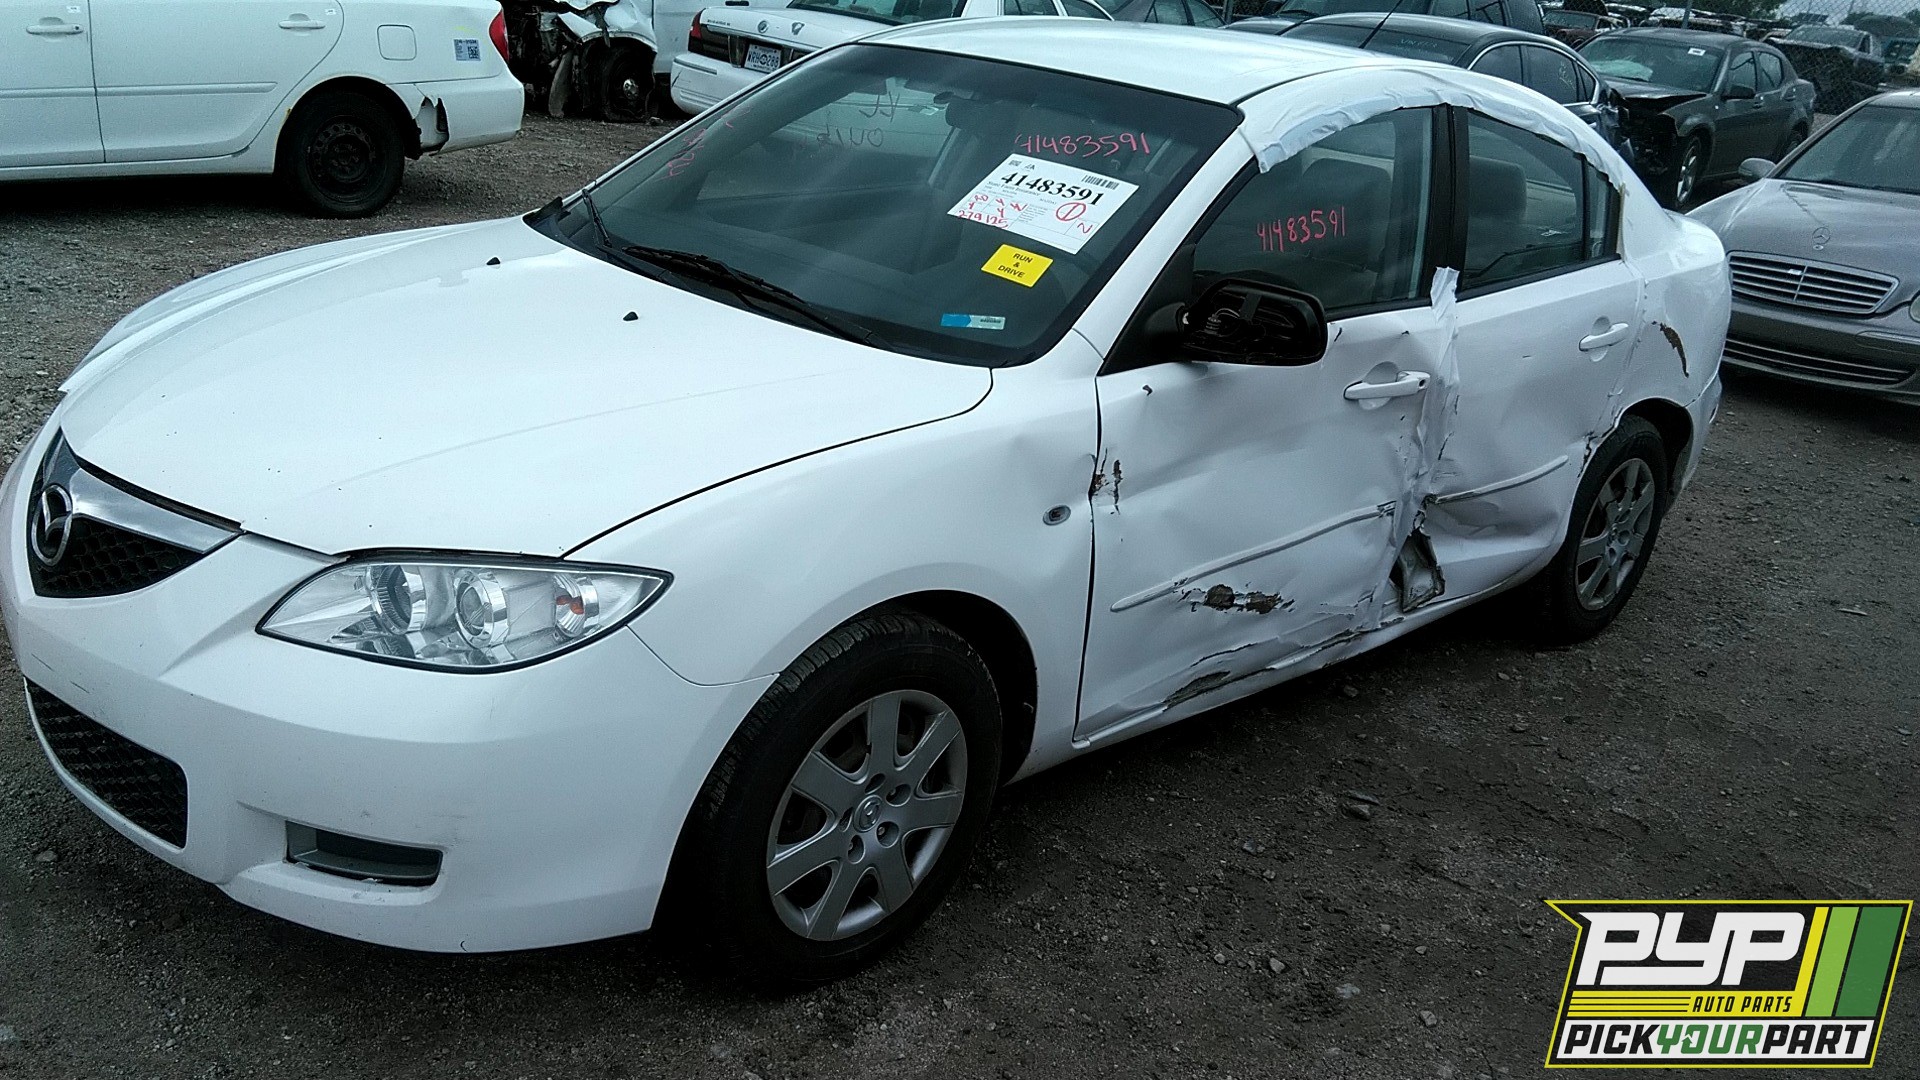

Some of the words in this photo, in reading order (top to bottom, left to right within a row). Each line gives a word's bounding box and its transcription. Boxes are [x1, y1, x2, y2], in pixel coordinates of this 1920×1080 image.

[1014, 132, 1150, 158] 41483591
[1001, 172, 1104, 205] 41483591
[1257, 206, 1346, 252] 41483591
[1013, 253, 1033, 263] RUN
[998, 265, 1025, 278] DRIVE
